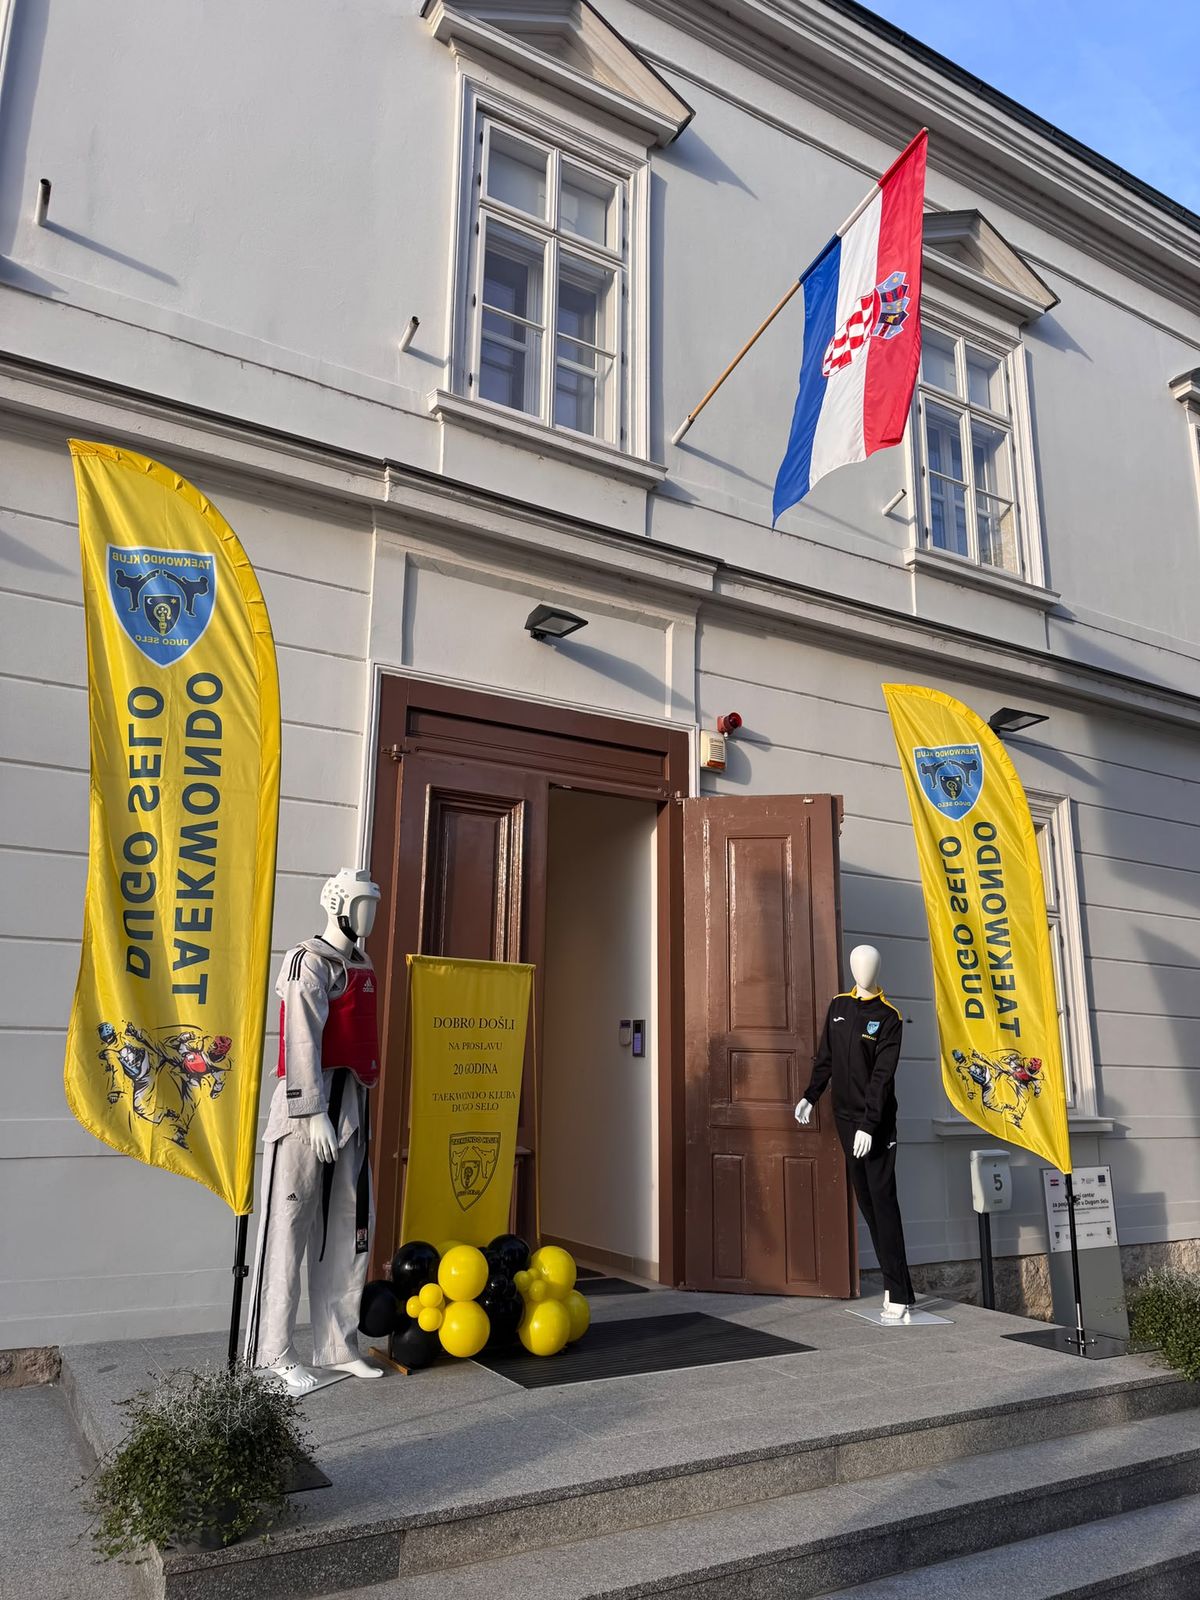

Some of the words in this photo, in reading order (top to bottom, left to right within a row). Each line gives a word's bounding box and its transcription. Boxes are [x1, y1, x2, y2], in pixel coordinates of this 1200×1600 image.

[433, 1017, 475, 1029] DOBRO
[479, 1016, 515, 1030] DOŠLI
[448, 1042, 460, 1051] NA
[453, 1063, 464, 1075] 20
[488, 1090, 516, 1100] KLUBA
[475, 1102, 499, 1111] SELO
[993, 1174, 1003, 1191] 5
